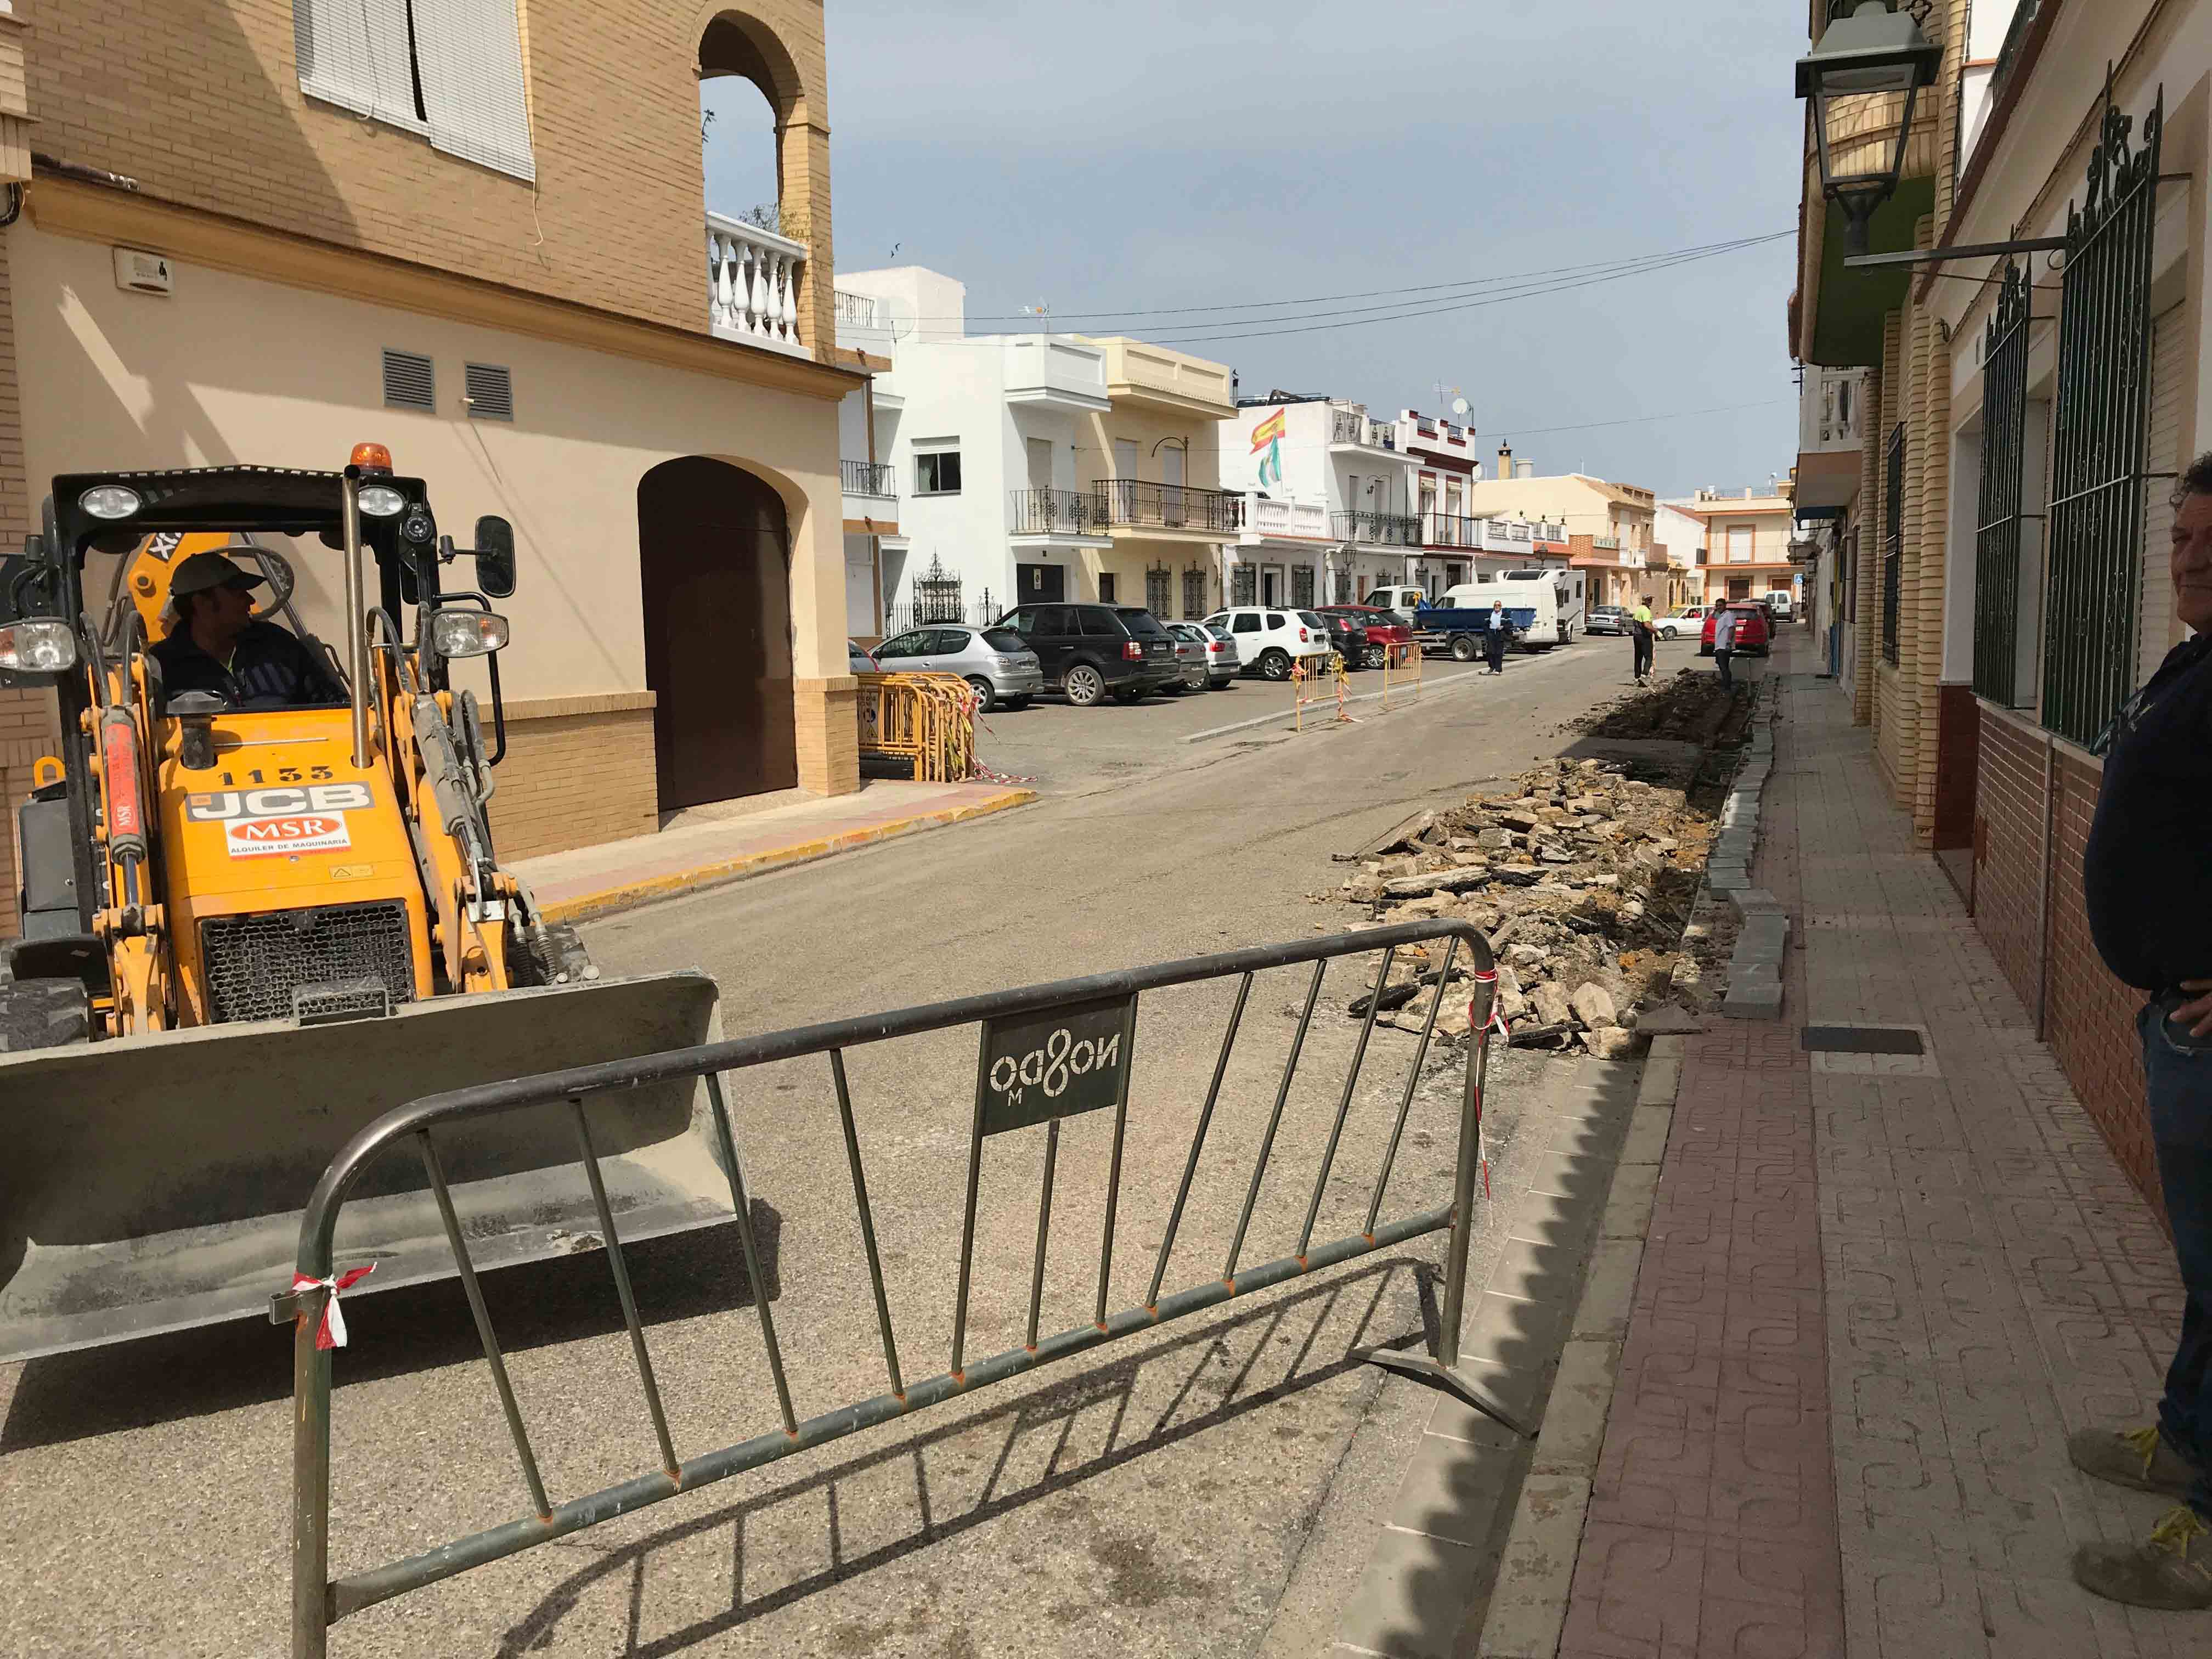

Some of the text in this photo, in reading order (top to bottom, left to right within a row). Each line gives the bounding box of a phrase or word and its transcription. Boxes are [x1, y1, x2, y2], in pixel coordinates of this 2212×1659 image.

[192, 784, 369, 819] JCB
[246, 820, 327, 840] MSR
[231, 843, 274, 853] ALQUILER
[292, 839, 347, 848] MAQUINARIA
